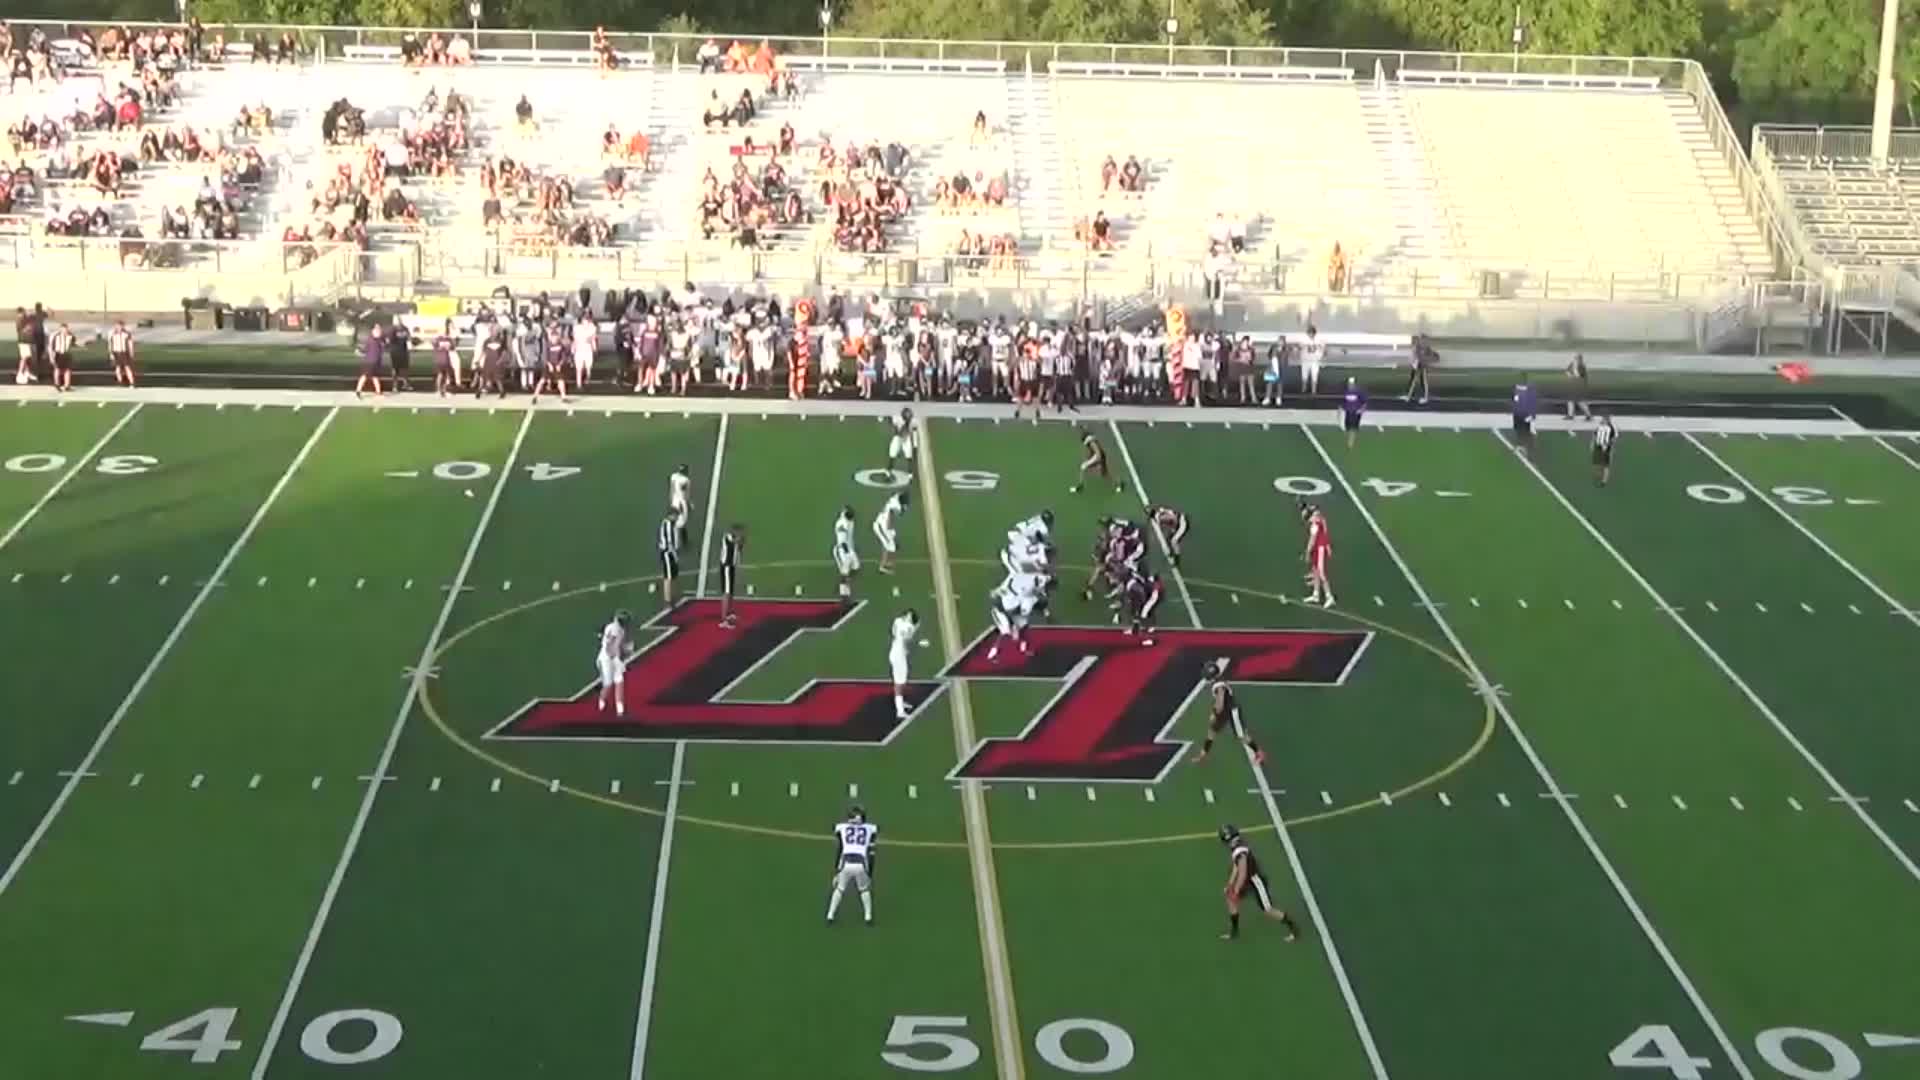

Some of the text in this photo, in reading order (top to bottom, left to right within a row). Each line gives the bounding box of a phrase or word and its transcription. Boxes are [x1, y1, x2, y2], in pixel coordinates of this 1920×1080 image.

[845, 826, 867, 846] 22
[140, 1006, 404, 1065] 40
[881, 1014, 1135, 1074] 50
[1608, 1023, 1862, 1080] 40
